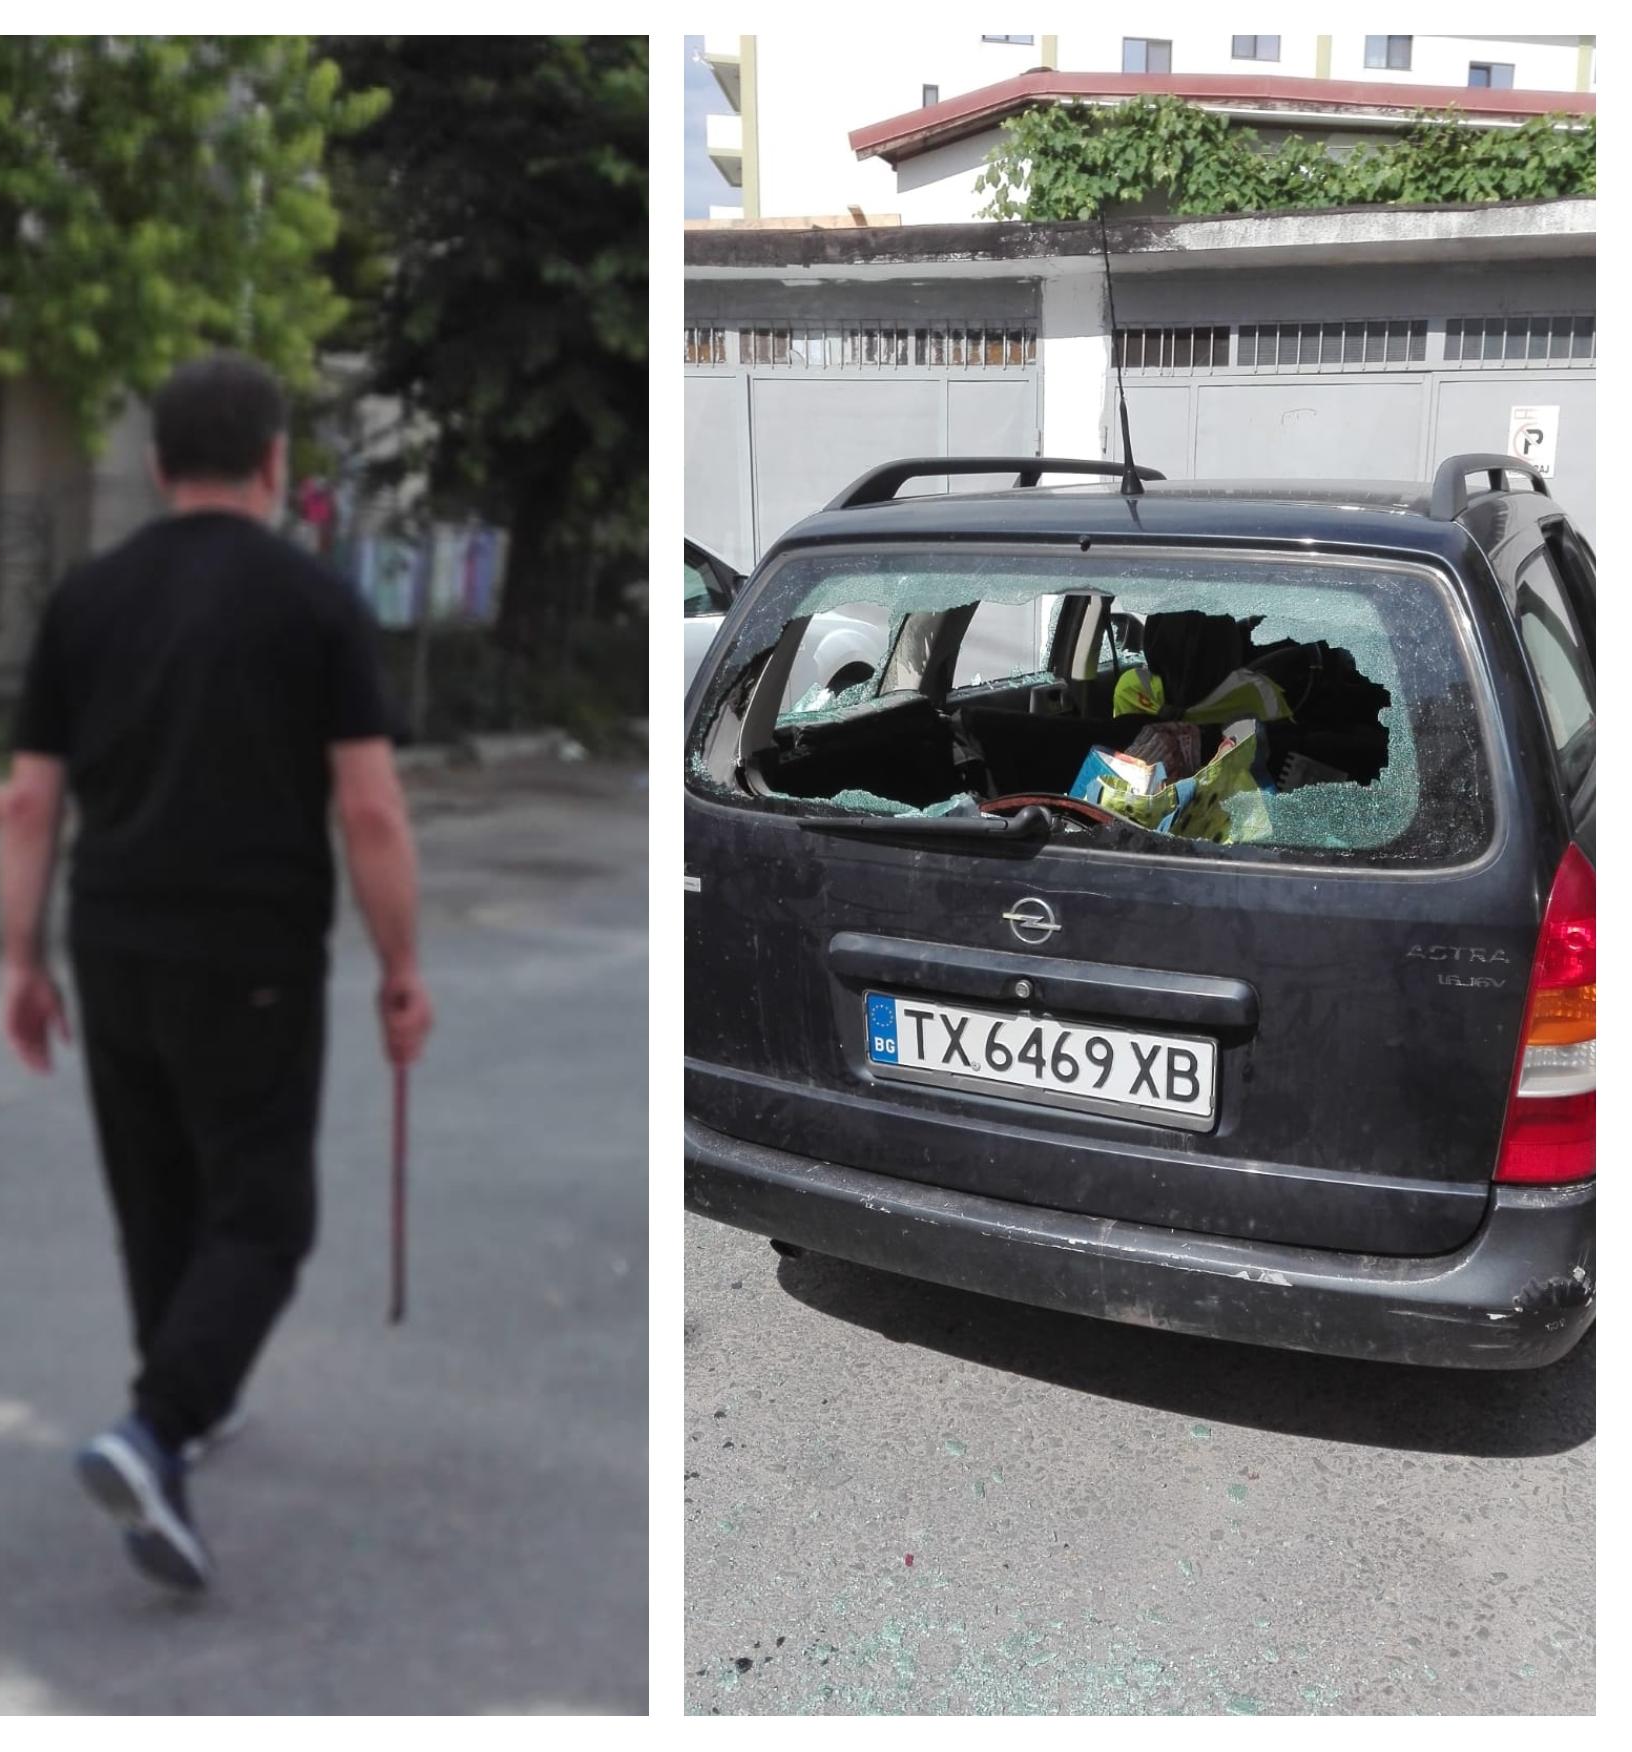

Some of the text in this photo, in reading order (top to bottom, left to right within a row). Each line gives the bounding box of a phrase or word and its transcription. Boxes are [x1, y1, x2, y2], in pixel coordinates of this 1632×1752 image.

[1406, 944, 1510, 963] ASTRA
[874, 1036, 896, 1054] BG
[903, 1008, 1200, 1103] TX 6469 XB
